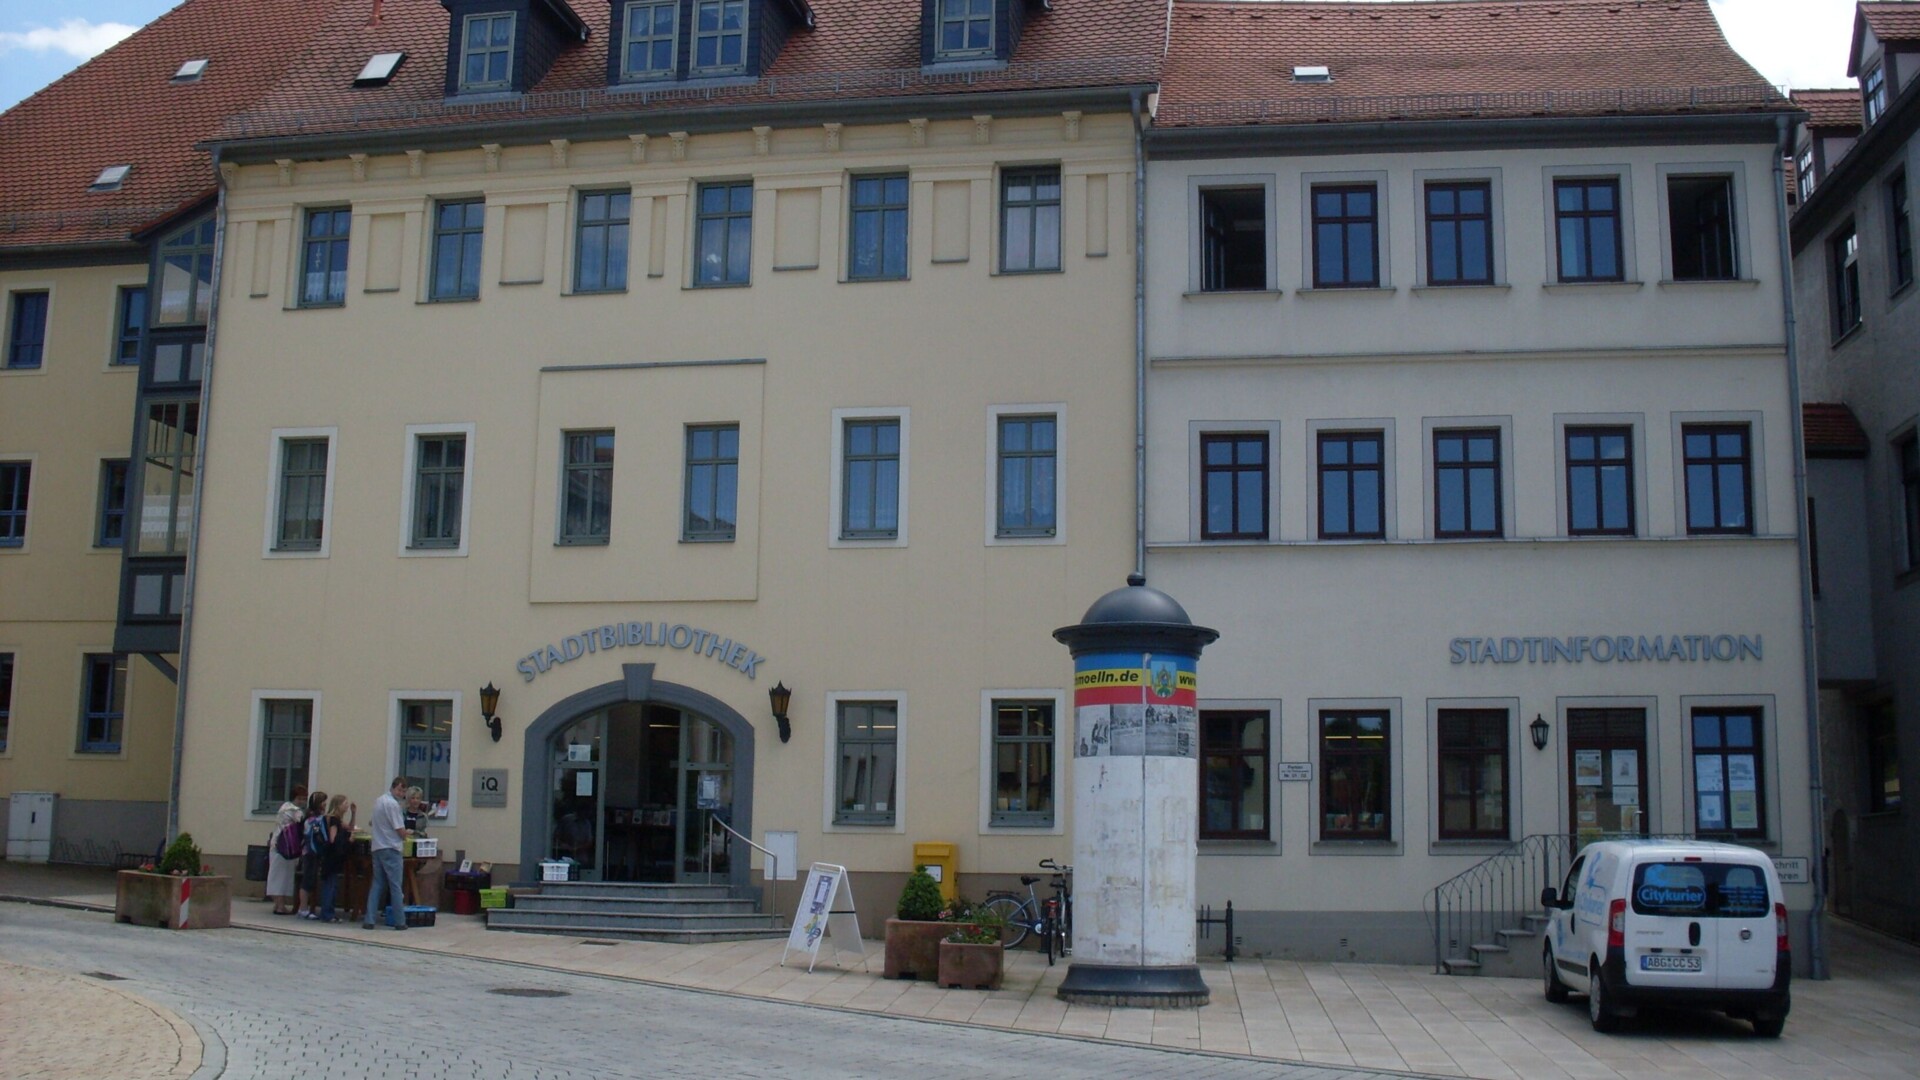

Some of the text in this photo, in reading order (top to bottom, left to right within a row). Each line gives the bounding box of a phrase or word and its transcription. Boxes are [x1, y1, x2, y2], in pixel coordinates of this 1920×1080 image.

[516, 621, 766, 683] STADTBIBLIOTHEK
[1450, 634, 1763, 664] STADTINFORMATION
[1075, 670, 1139, 685] moelln.de
[481, 776, 498, 791] iQ
[1774, 861, 1799, 869] chritt
[1777, 872, 1799, 880] hren
[1641, 888, 1703, 904] Citykurier
[1687, 958, 1700, 969] 53
